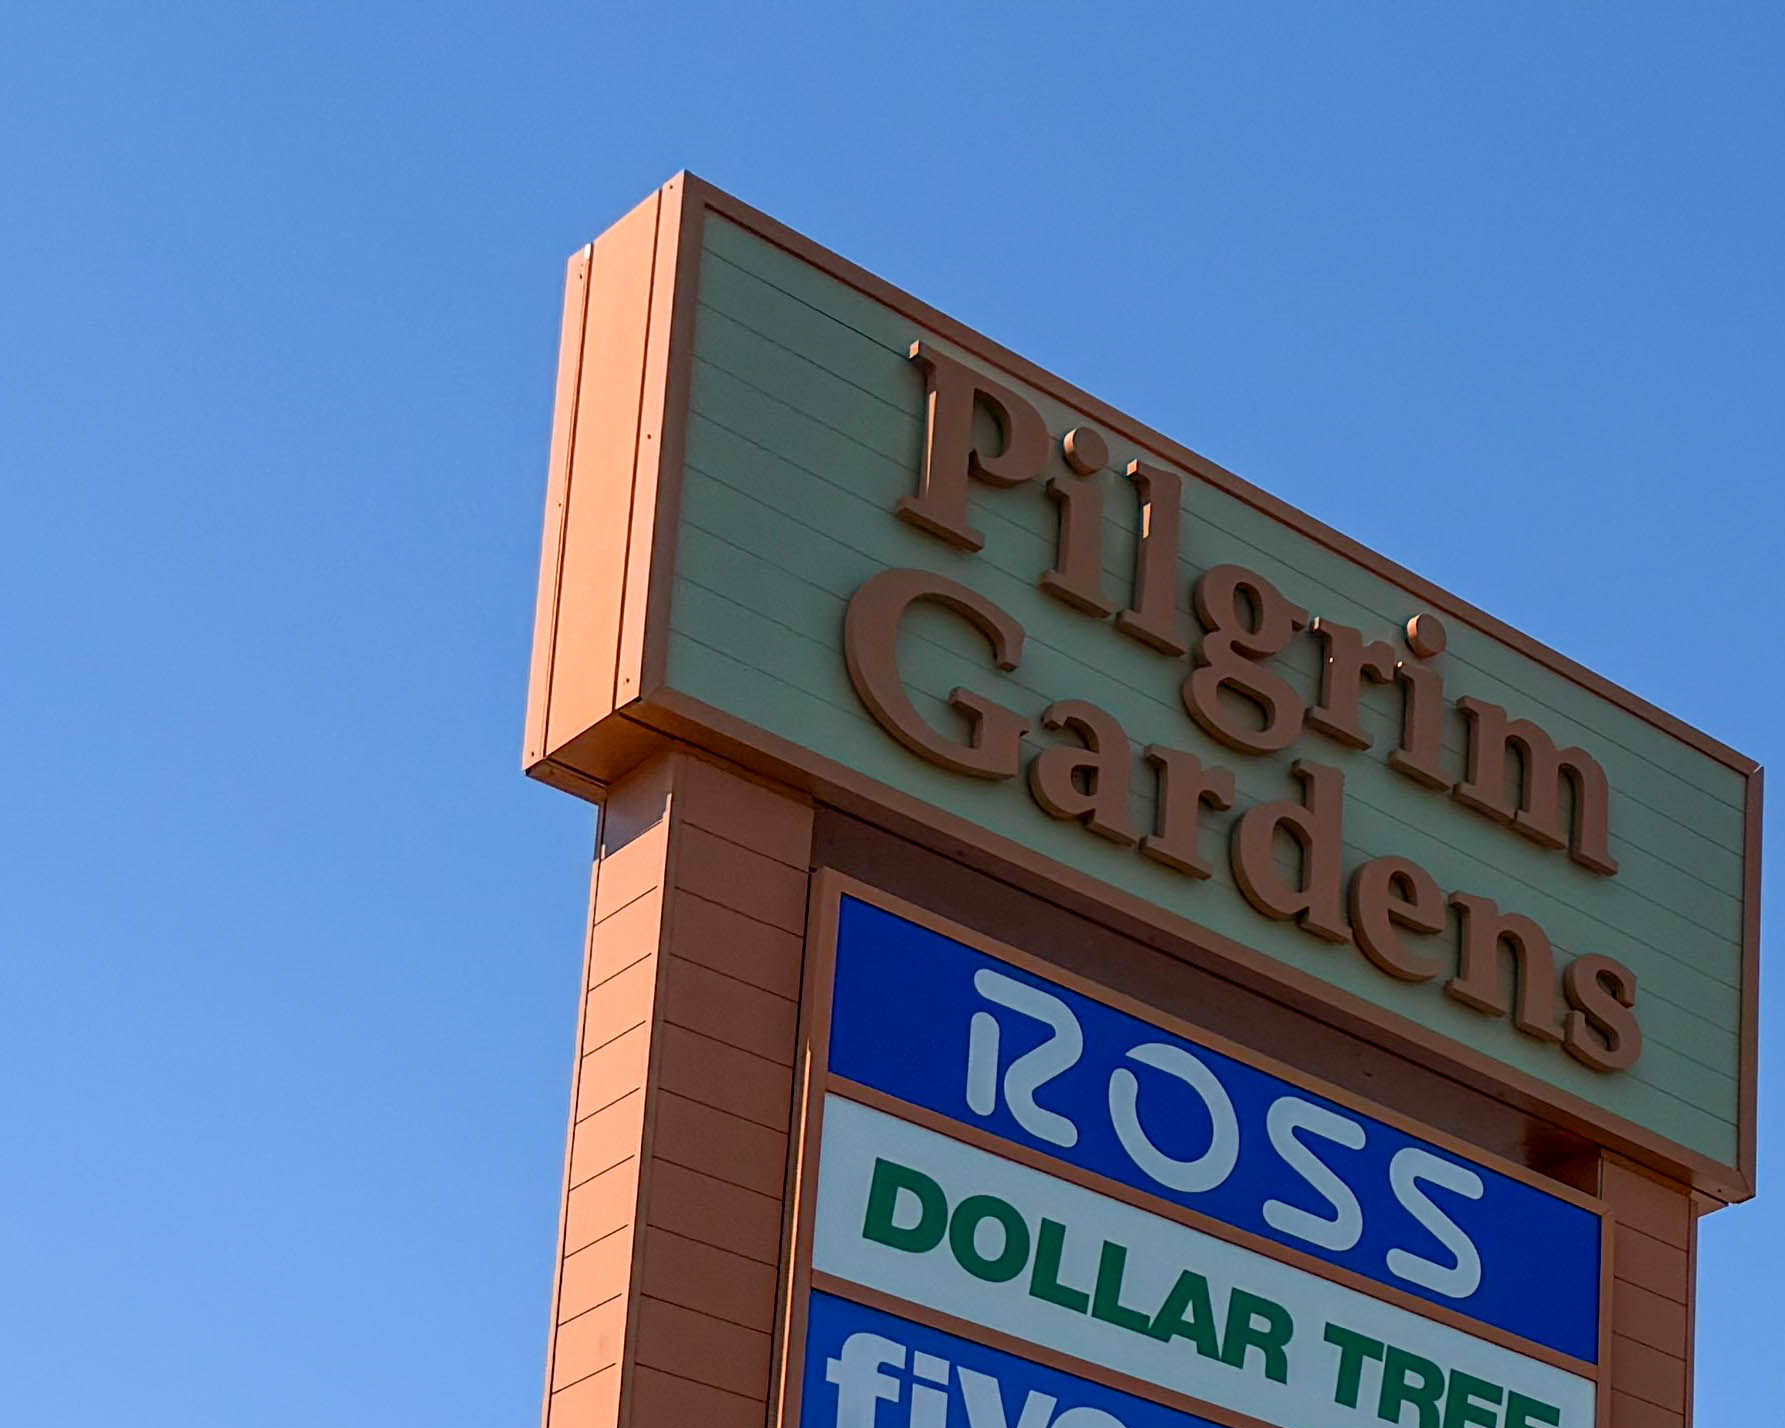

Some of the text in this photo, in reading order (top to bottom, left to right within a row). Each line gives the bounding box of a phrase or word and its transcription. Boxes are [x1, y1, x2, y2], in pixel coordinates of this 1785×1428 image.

[895, 338, 1619, 876] Pilgrim
[844, 568, 1644, 1074] Gardens
[862, 1157, 1294, 1386] DOLLAR
[966, 968, 1484, 1298] ROSS
